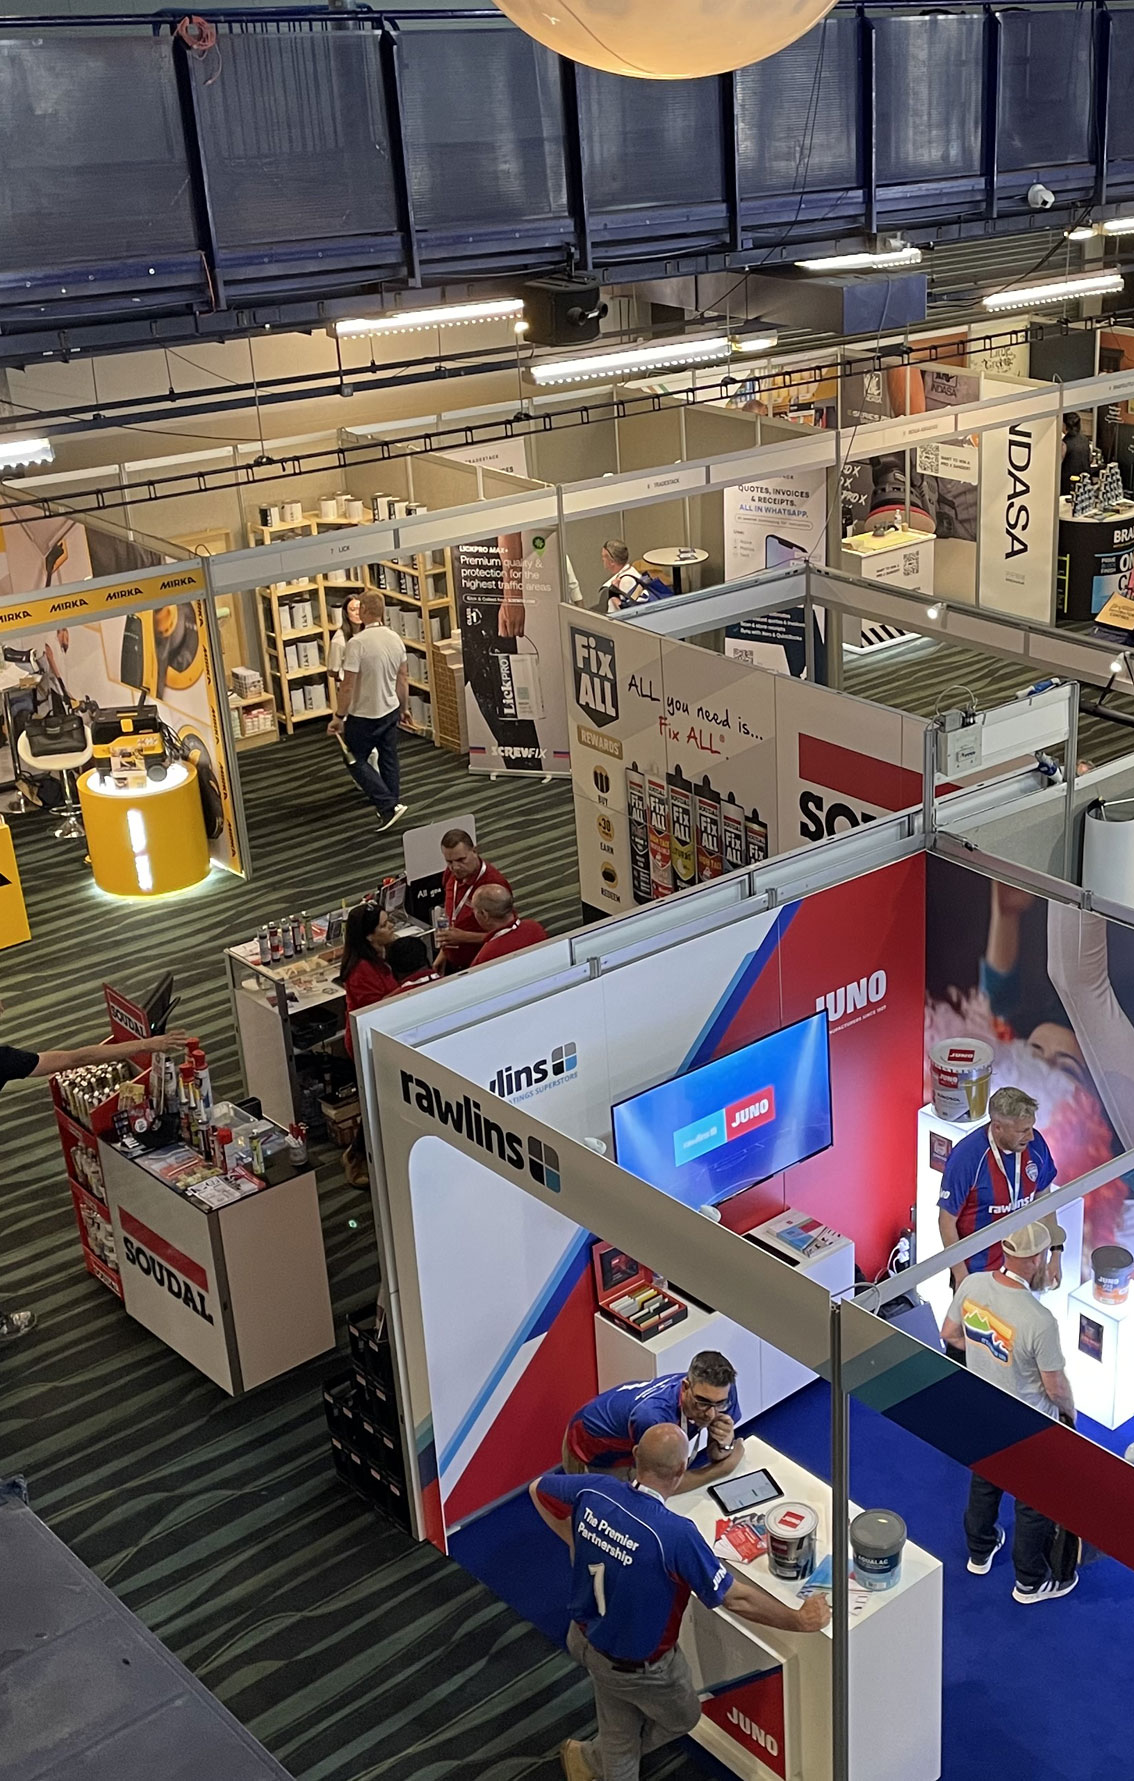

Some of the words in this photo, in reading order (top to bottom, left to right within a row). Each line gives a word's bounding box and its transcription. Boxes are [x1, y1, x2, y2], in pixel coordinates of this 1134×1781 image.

[738, 484, 771, 496] QUOTES,
[773, 487, 810, 499] INVOICES
[757, 496, 796, 507] RECEIPTS.
[739, 503, 753, 513] ALL
[755, 504, 764, 513] IN
[338, 545, 350, 554] LICK
[460, 555, 501, 567] Premium
[503, 557, 532, 569] quality
[535, 559, 543, 568] &
[159, 576, 197, 590] MIRKA
[461, 567, 505, 581] protection
[509, 569, 522, 579] for
[524, 569, 539, 580] the
[462, 578, 496, 592] highest
[497, 579, 524, 591] traffic
[526, 582, 551, 593] areas
[50, 598, 89, 613] MIRKA
[105, 587, 144, 602] MIRKA
[578, 671, 617, 716] ALL
[627, 673, 661, 703] ALL
[666, 695, 691, 718] you
[696, 704, 731, 729] need
[738, 715, 764, 742] is...
[579, 728, 621, 757] REWARDS
[658, 716, 681, 743] Fix
[686, 727, 722, 756] ALL
[110, 1002, 148, 1039] SOUDAL
[535, 1071, 578, 1095] SUPERSTORE
[400, 1066, 525, 1172] rawlins
[731, 1098, 769, 1128] JUNO
[123, 1233, 215, 1327] SOUDAL
[577, 1521, 633, 1567] Partnership
[583, 1507, 599, 1528] The
[598, 1519, 640, 1552] Premier
[587, 1561, 606, 1617] 1
[725, 1705, 780, 1759] JUNO
